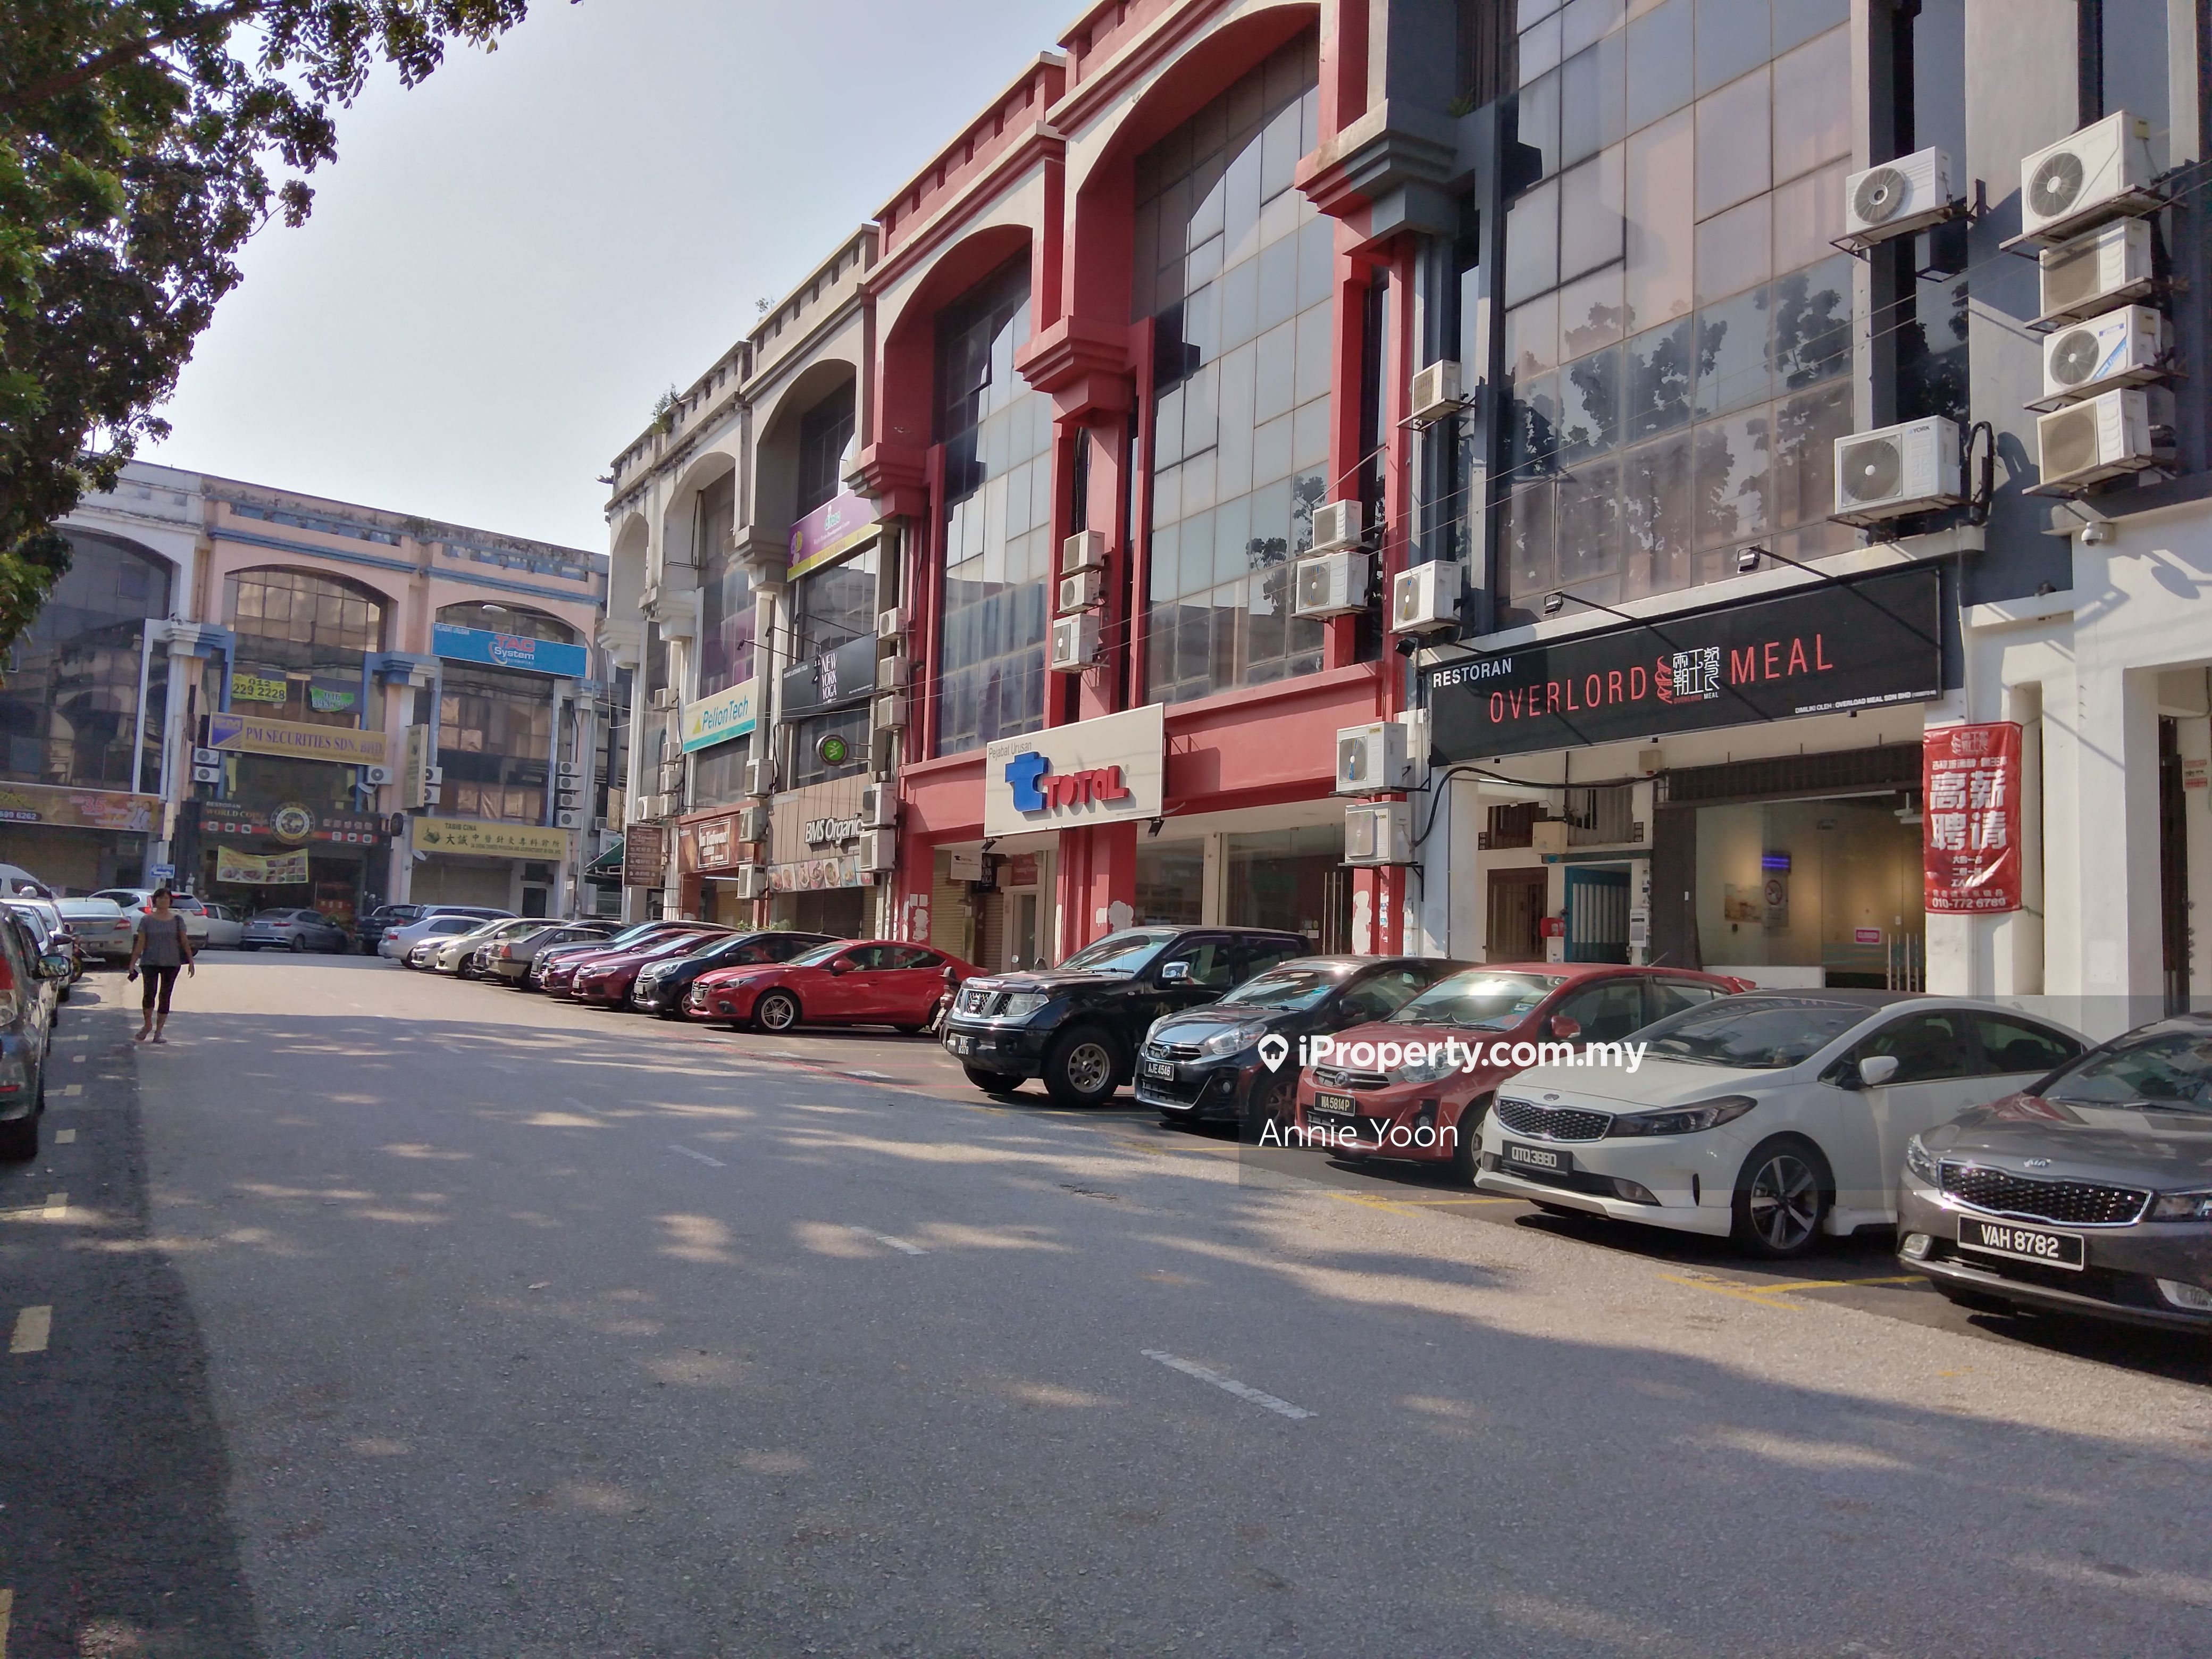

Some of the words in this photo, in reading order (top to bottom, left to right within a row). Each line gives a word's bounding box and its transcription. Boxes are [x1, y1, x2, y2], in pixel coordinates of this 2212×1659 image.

[495, 634, 535, 652] TAC
[494, 646, 535, 660] System
[1731, 633, 1833, 685] MEAL
[822, 652, 838, 673] NEW
[822, 670, 837, 688] YORK
[1433, 657, 1512, 688] RESTORAN
[232, 683, 254, 696] 229
[257, 687, 285, 700] 2228
[248, 678, 271, 687] 012
[822, 683, 837, 700] YOGA
[1490, 666, 1647, 723] OVERLORD
[1704, 692, 1719, 700] MEAL
[1835, 698, 1866, 708] OVERLOAD
[1898, 691, 1912, 700] BHD
[246, 726, 263, 741] PM
[265, 730, 331, 749] SECURITIES
[334, 736, 357, 752] SDN.
[360, 741, 384, 755] BHD.
[988, 745, 1010, 761] Pejabat
[1011, 741, 1032, 755] Urusan
[1042, 765, 1130, 809] TOTAL
[1930, 769, 2006, 810] 高薪
[81, 797, 106, 812] 35
[206, 809, 238, 817] WORLD
[16, 811, 37, 820] 6262
[706, 830, 728, 846] Taiwan
[805, 820, 824, 843] BMS
[825, 813, 865, 847] Organic
[1930, 810, 2007, 850] 聘请
[958, 1045, 969, 1055] 8378
[1147, 1063, 1158, 1074] AJE
[1981, 1223, 2010, 1250] VAH
[2013, 1230, 2059, 1259] 8782
